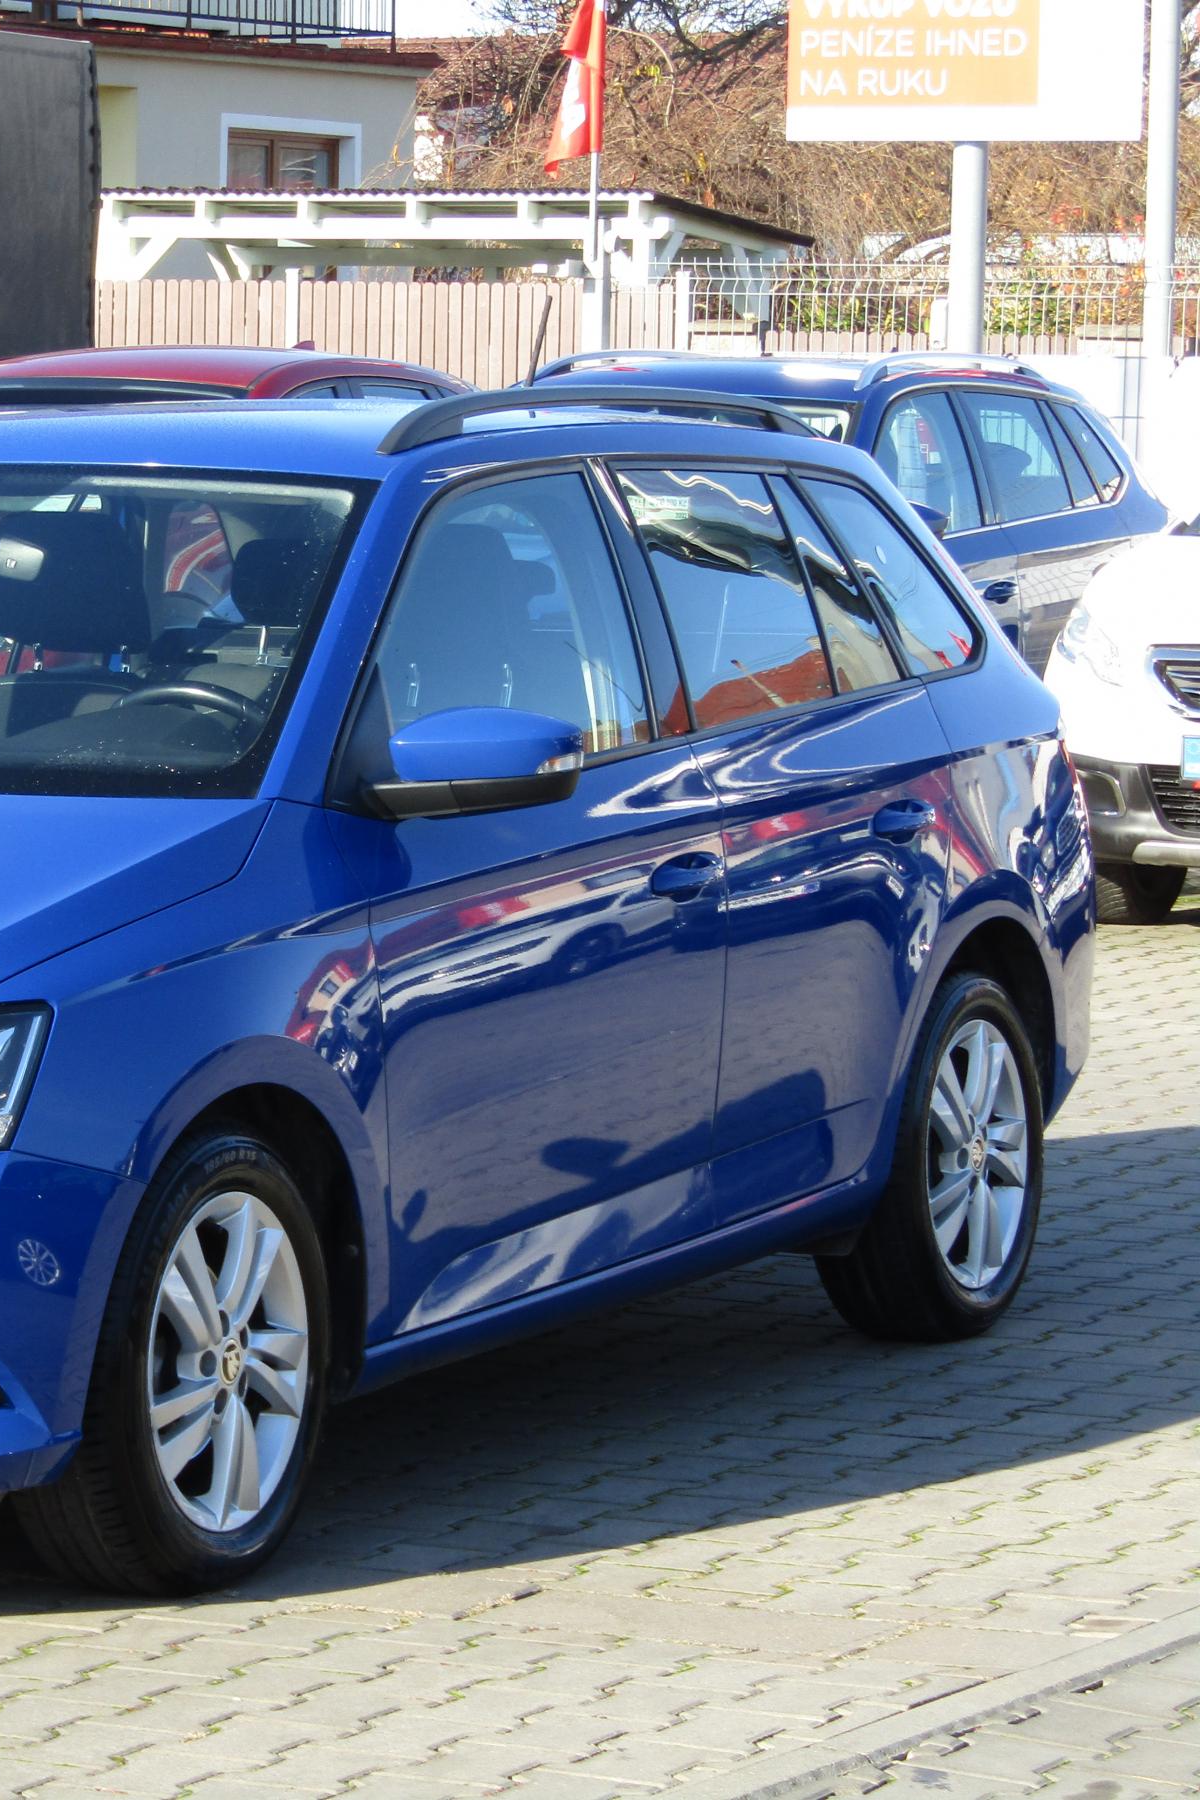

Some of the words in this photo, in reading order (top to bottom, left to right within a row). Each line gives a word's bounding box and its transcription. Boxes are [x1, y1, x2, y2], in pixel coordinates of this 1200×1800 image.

[800, 26, 915, 57] PENÍZE
[926, 28, 1027, 57] IHNED
[800, 69, 847, 96] NA
[857, 69, 948, 96] RUKU
